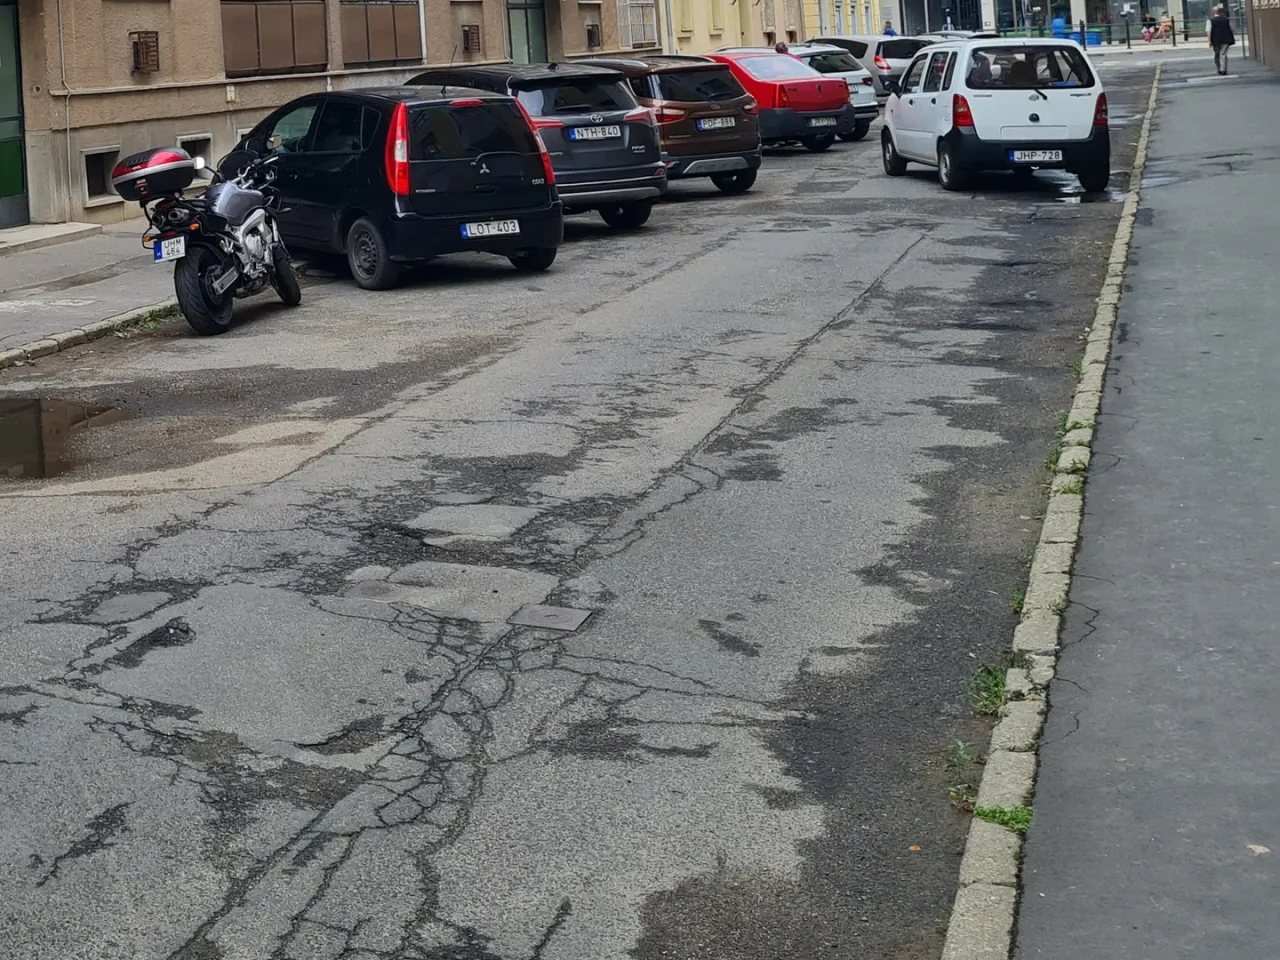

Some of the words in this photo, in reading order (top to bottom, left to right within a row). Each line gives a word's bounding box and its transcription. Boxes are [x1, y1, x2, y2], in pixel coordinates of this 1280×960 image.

[576, 126, 619, 138] NTH-840
[1016, 150, 1061, 160] JHP-728
[469, 220, 517, 236] LOT-403
[163, 239, 182, 249] UHM
